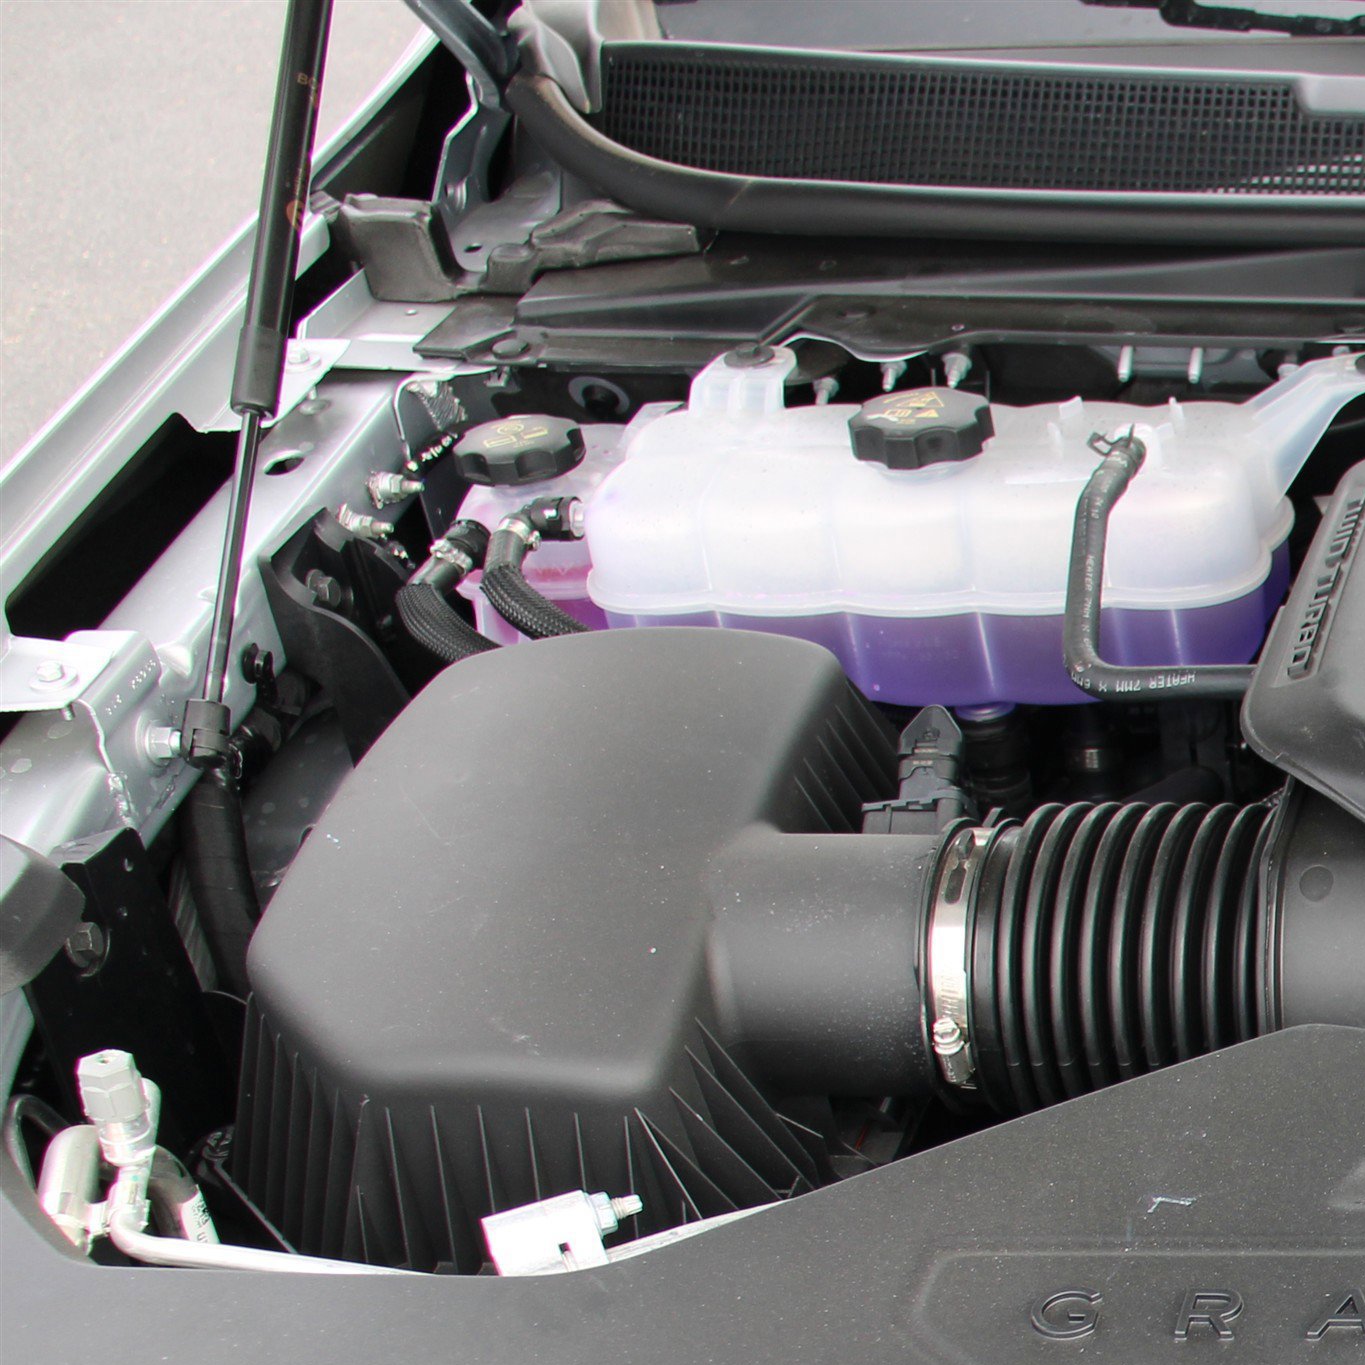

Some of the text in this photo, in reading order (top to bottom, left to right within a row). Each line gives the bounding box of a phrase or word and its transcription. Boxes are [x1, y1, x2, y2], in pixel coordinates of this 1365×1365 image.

[1287, 562, 1342, 679] TURBO
[1099, 682, 1108, 692] X
[1115, 679, 1141, 692] 7MM
[1149, 672, 1196, 689] HEATER
